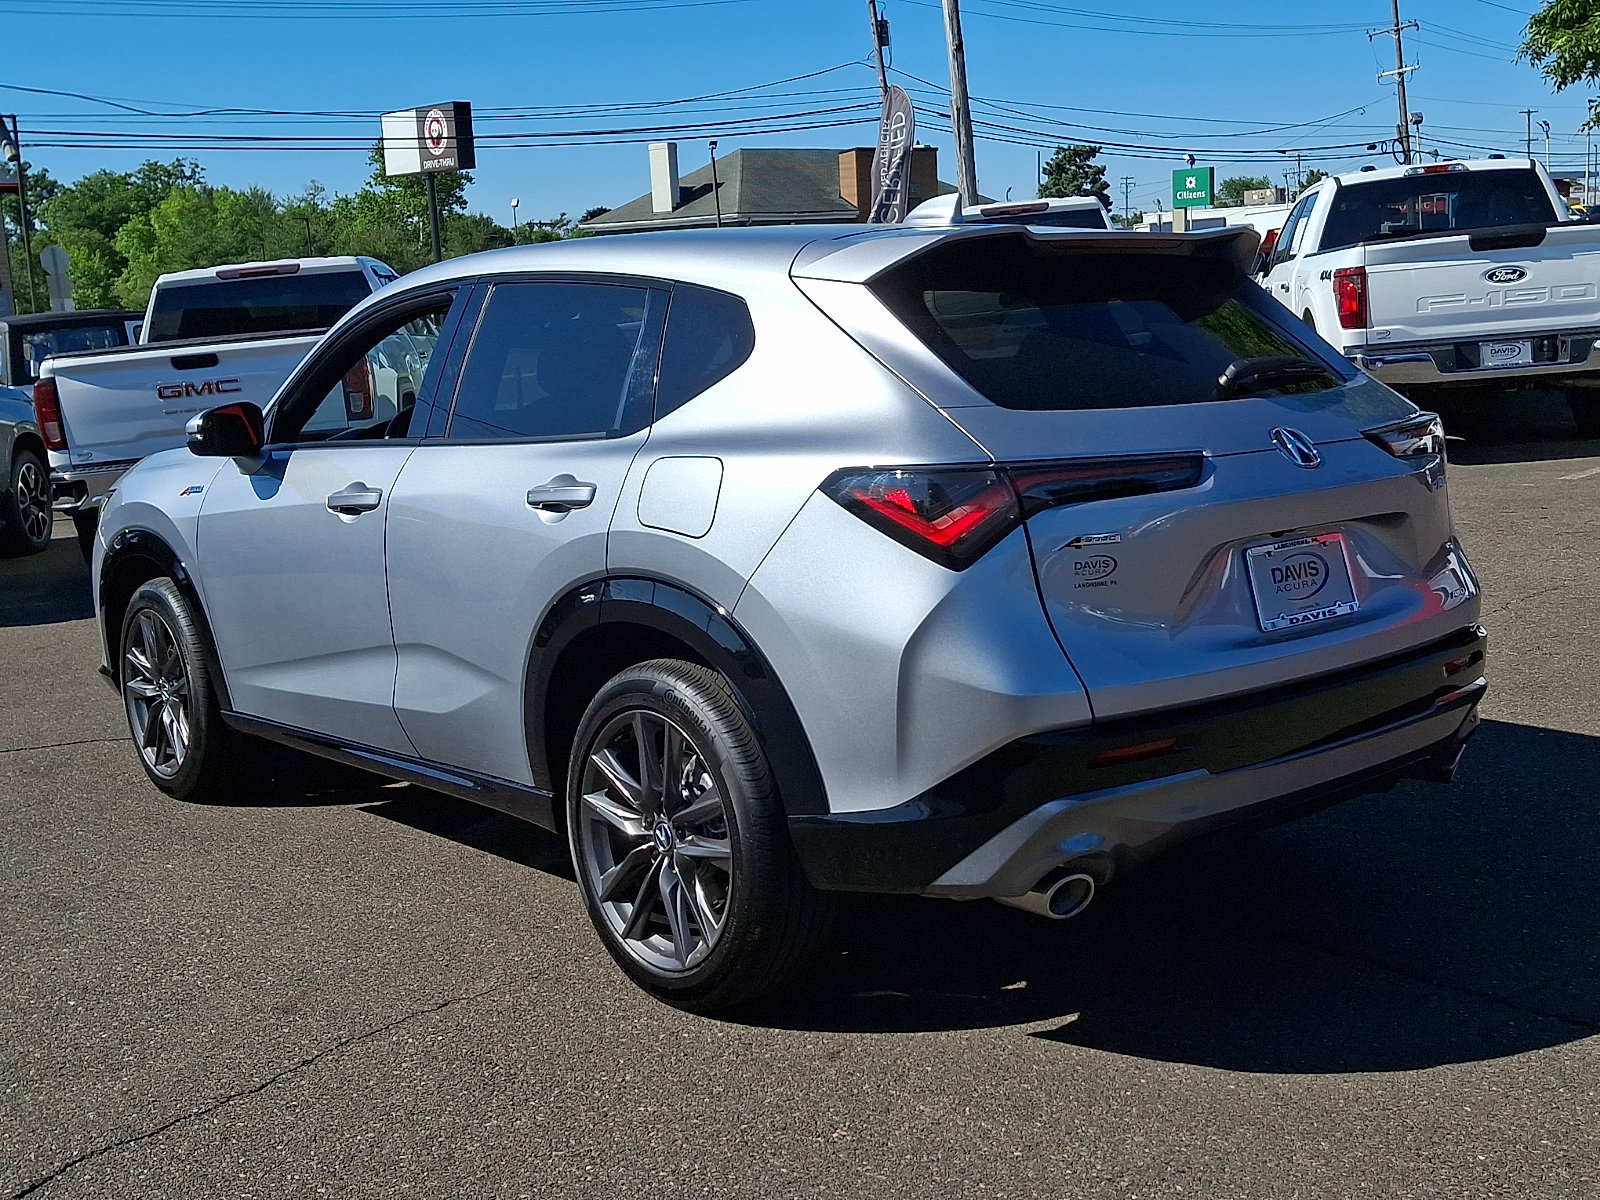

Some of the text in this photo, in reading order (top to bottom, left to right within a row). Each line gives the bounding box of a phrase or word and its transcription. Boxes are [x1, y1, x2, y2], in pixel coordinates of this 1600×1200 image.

[423, 157, 455, 169] DRIVE-THRU
[1176, 190, 1206, 200] Citizens
[1492, 269, 1521, 281] Ford
[1417, 282, 1598, 313] F-150
[1490, 347, 1516, 355] DAVIS
[157, 378, 242, 400] GMC
[1074, 560, 1110, 571] DAVIS
[1271, 560, 1320, 585] DAVIS
[1275, 579, 1318, 594] ACURA
[1289, 608, 1338, 625] DAVIS
